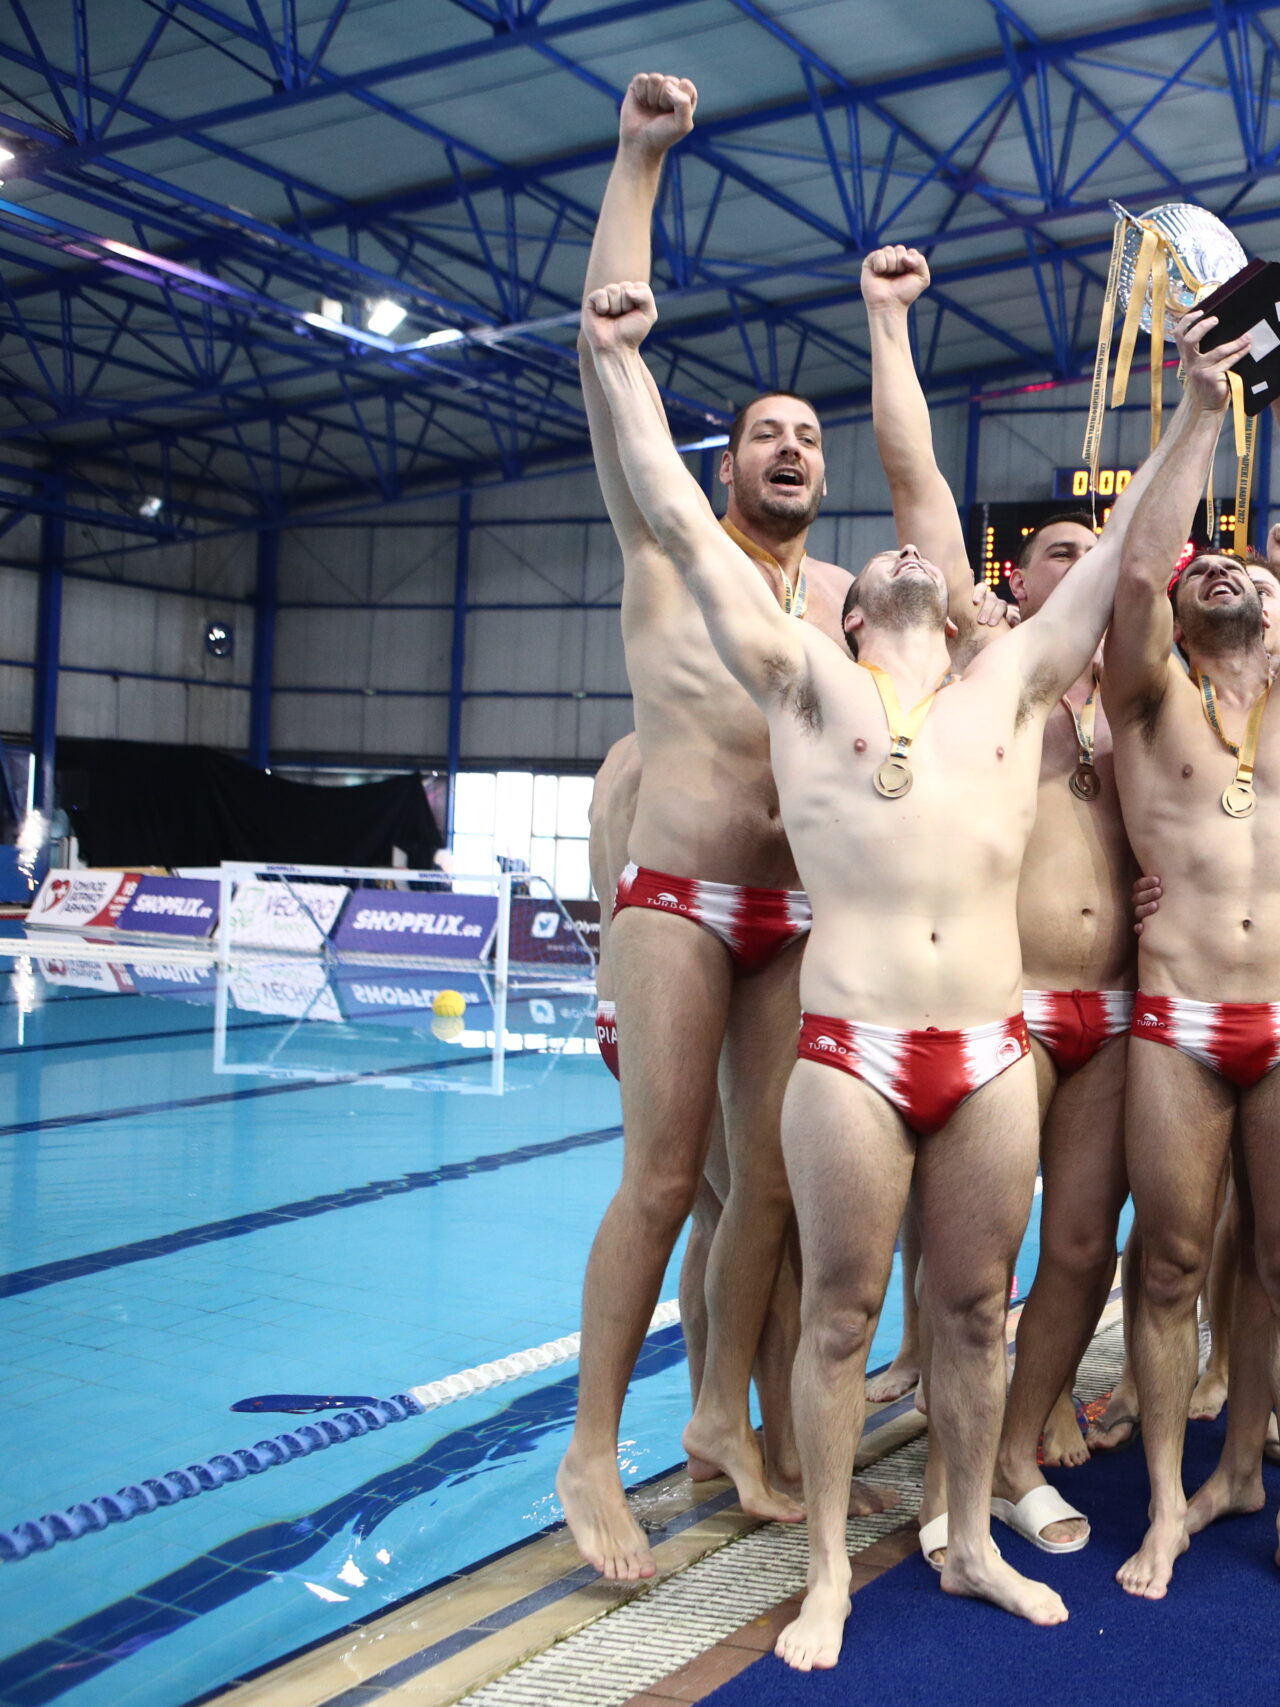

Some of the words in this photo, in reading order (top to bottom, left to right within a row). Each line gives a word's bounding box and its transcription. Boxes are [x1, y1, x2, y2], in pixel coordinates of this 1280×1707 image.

[1098, 342, 1106, 356] 2022
[1237, 509, 1245, 523] 2022
[647, 897, 688, 911] TURBO
[352, 908, 483, 938] SHOPFLIX.GR
[808, 1042, 847, 1055] TURBO
